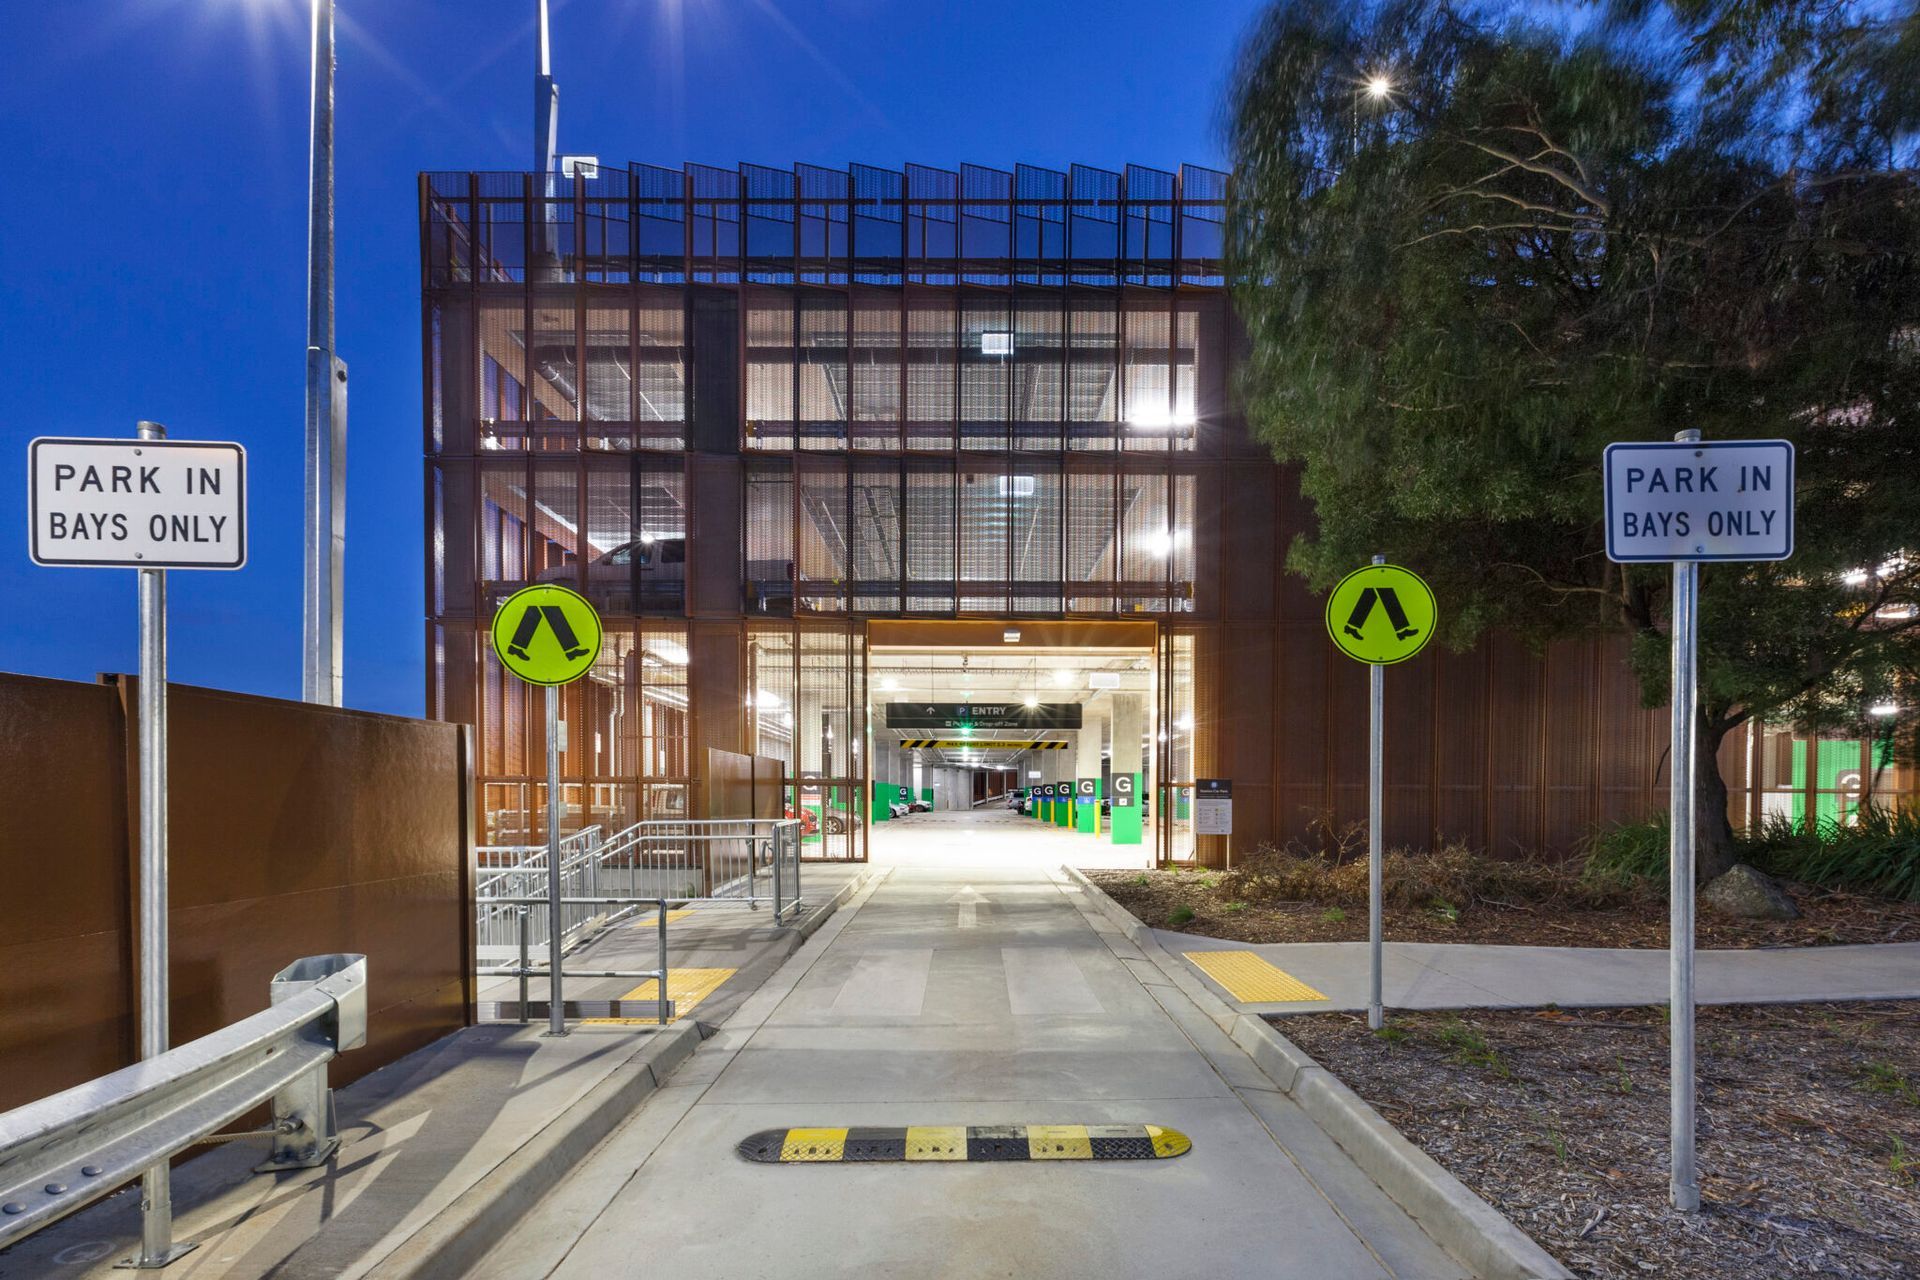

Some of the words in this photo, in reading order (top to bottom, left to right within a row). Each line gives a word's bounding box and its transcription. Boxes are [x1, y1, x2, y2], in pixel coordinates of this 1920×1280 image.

[55, 464, 161, 493] PARK
[187, 467, 220, 495] IN
[1627, 466, 1718, 493] PARK
[1741, 465, 1771, 491] IN
[50, 512, 128, 540] BAYS
[150, 514, 227, 542] ONLY
[1623, 511, 1690, 537] BAYS
[1708, 510, 1776, 536] ONLY
[972, 706, 1006, 715] ENTRY
[1033, 787, 1042, 795] G
[1044, 785, 1054, 795] G
[1059, 784, 1070, 794] G
[1081, 781, 1093, 793] G
[1116, 777, 1131, 792] G
